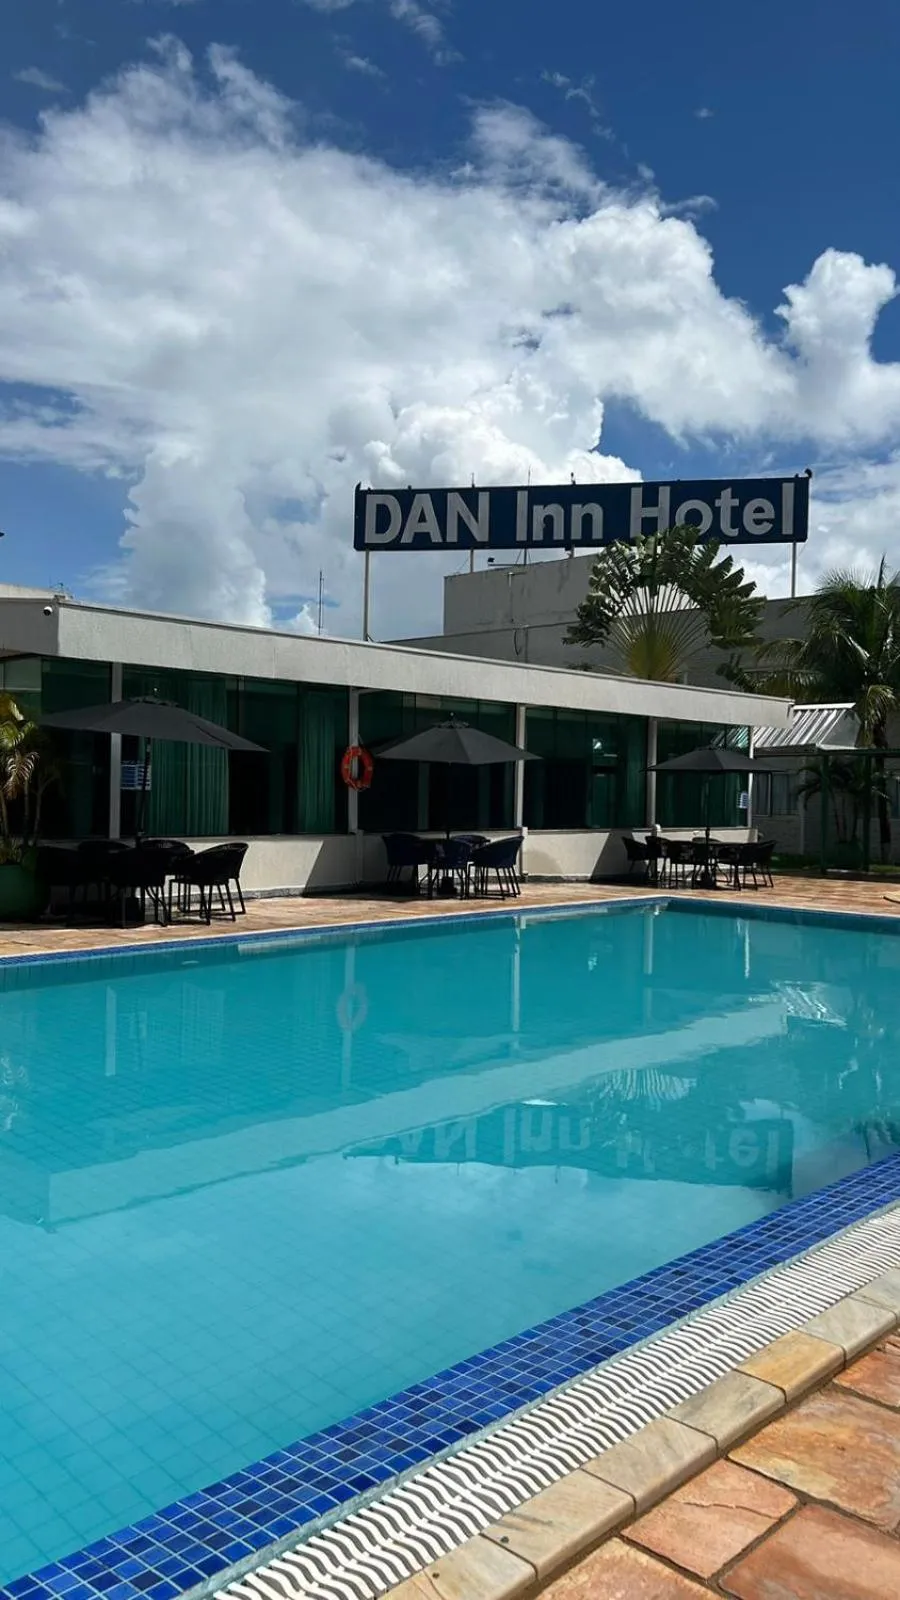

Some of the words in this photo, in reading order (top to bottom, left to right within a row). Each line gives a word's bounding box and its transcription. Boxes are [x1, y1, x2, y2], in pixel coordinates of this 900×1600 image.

[364, 491, 491, 544] DAN
[515, 489, 604, 542] Inn
[629, 481, 796, 540] Hotel
